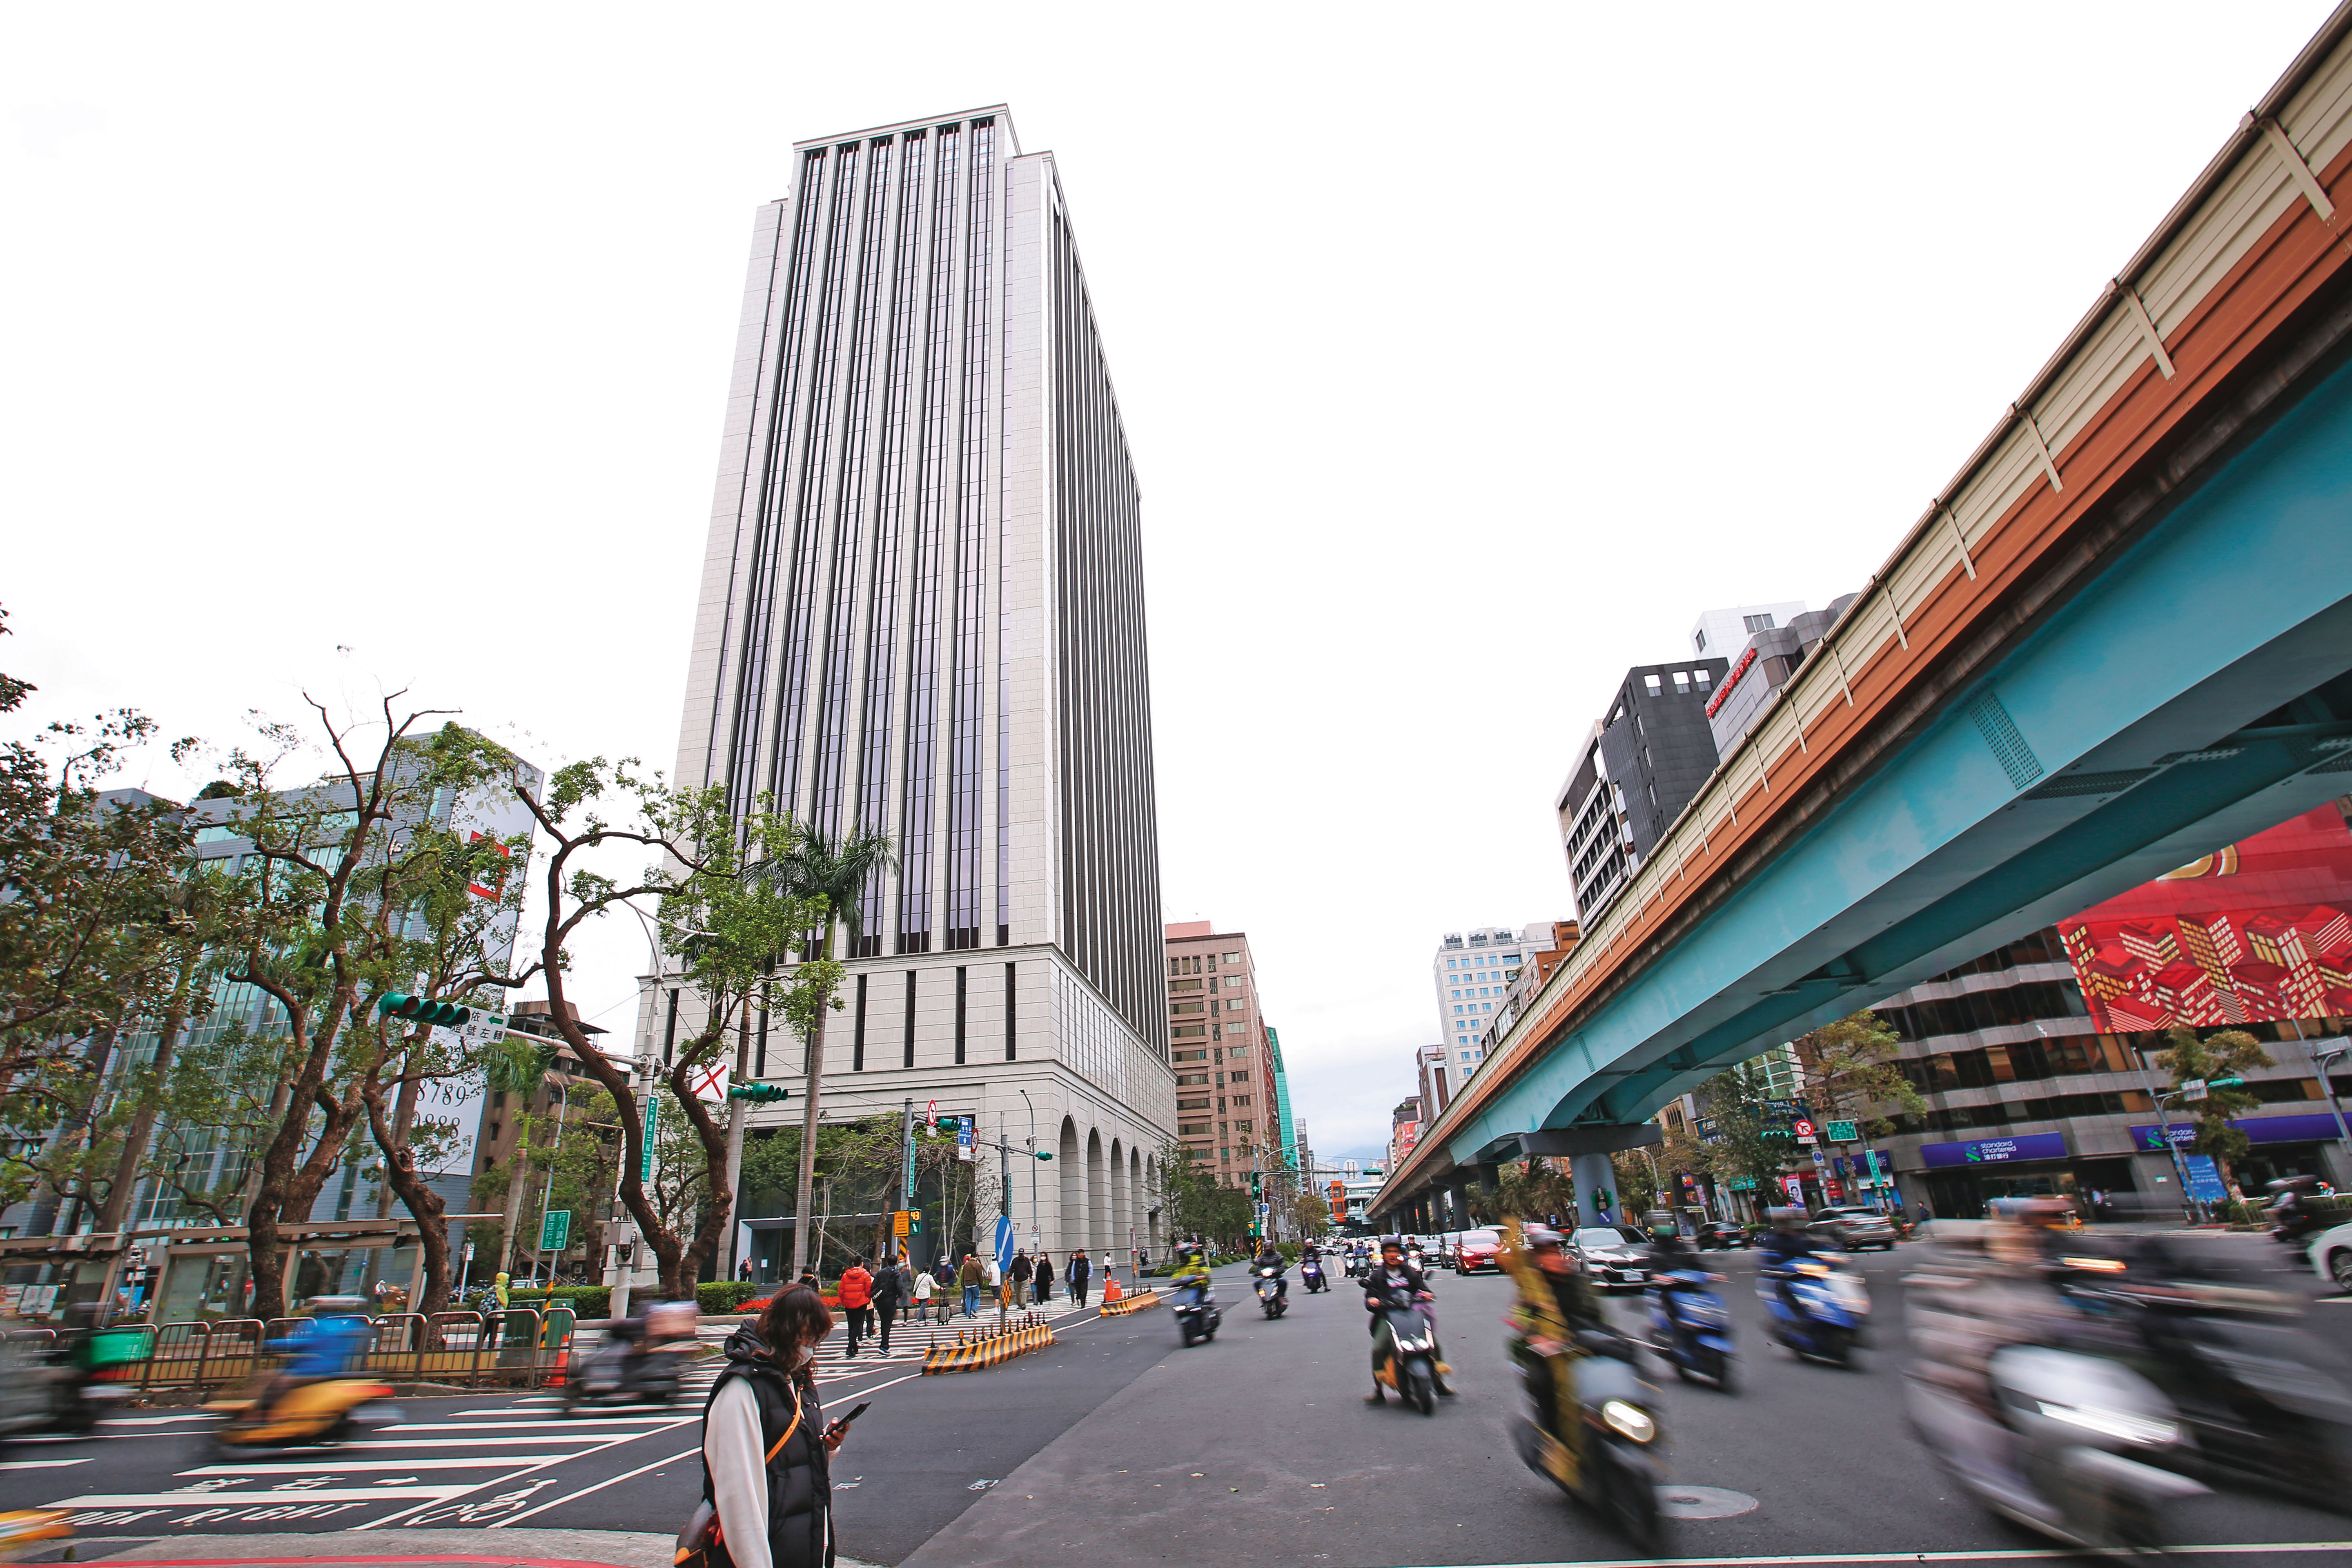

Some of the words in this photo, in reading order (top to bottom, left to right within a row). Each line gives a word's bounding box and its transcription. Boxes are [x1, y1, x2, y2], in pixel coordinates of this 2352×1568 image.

[471, 1010, 481, 1022] 依
[1980, 1140, 2013, 1149] standard
[1982, 1145, 2016, 1154] chartered
[910, 1211, 920, 1221] 43
[544, 1213, 555, 1248] 號誌行止
[556, 1213, 566, 1248] 行人請依
[168, 1503, 370, 1523] RIGHT
